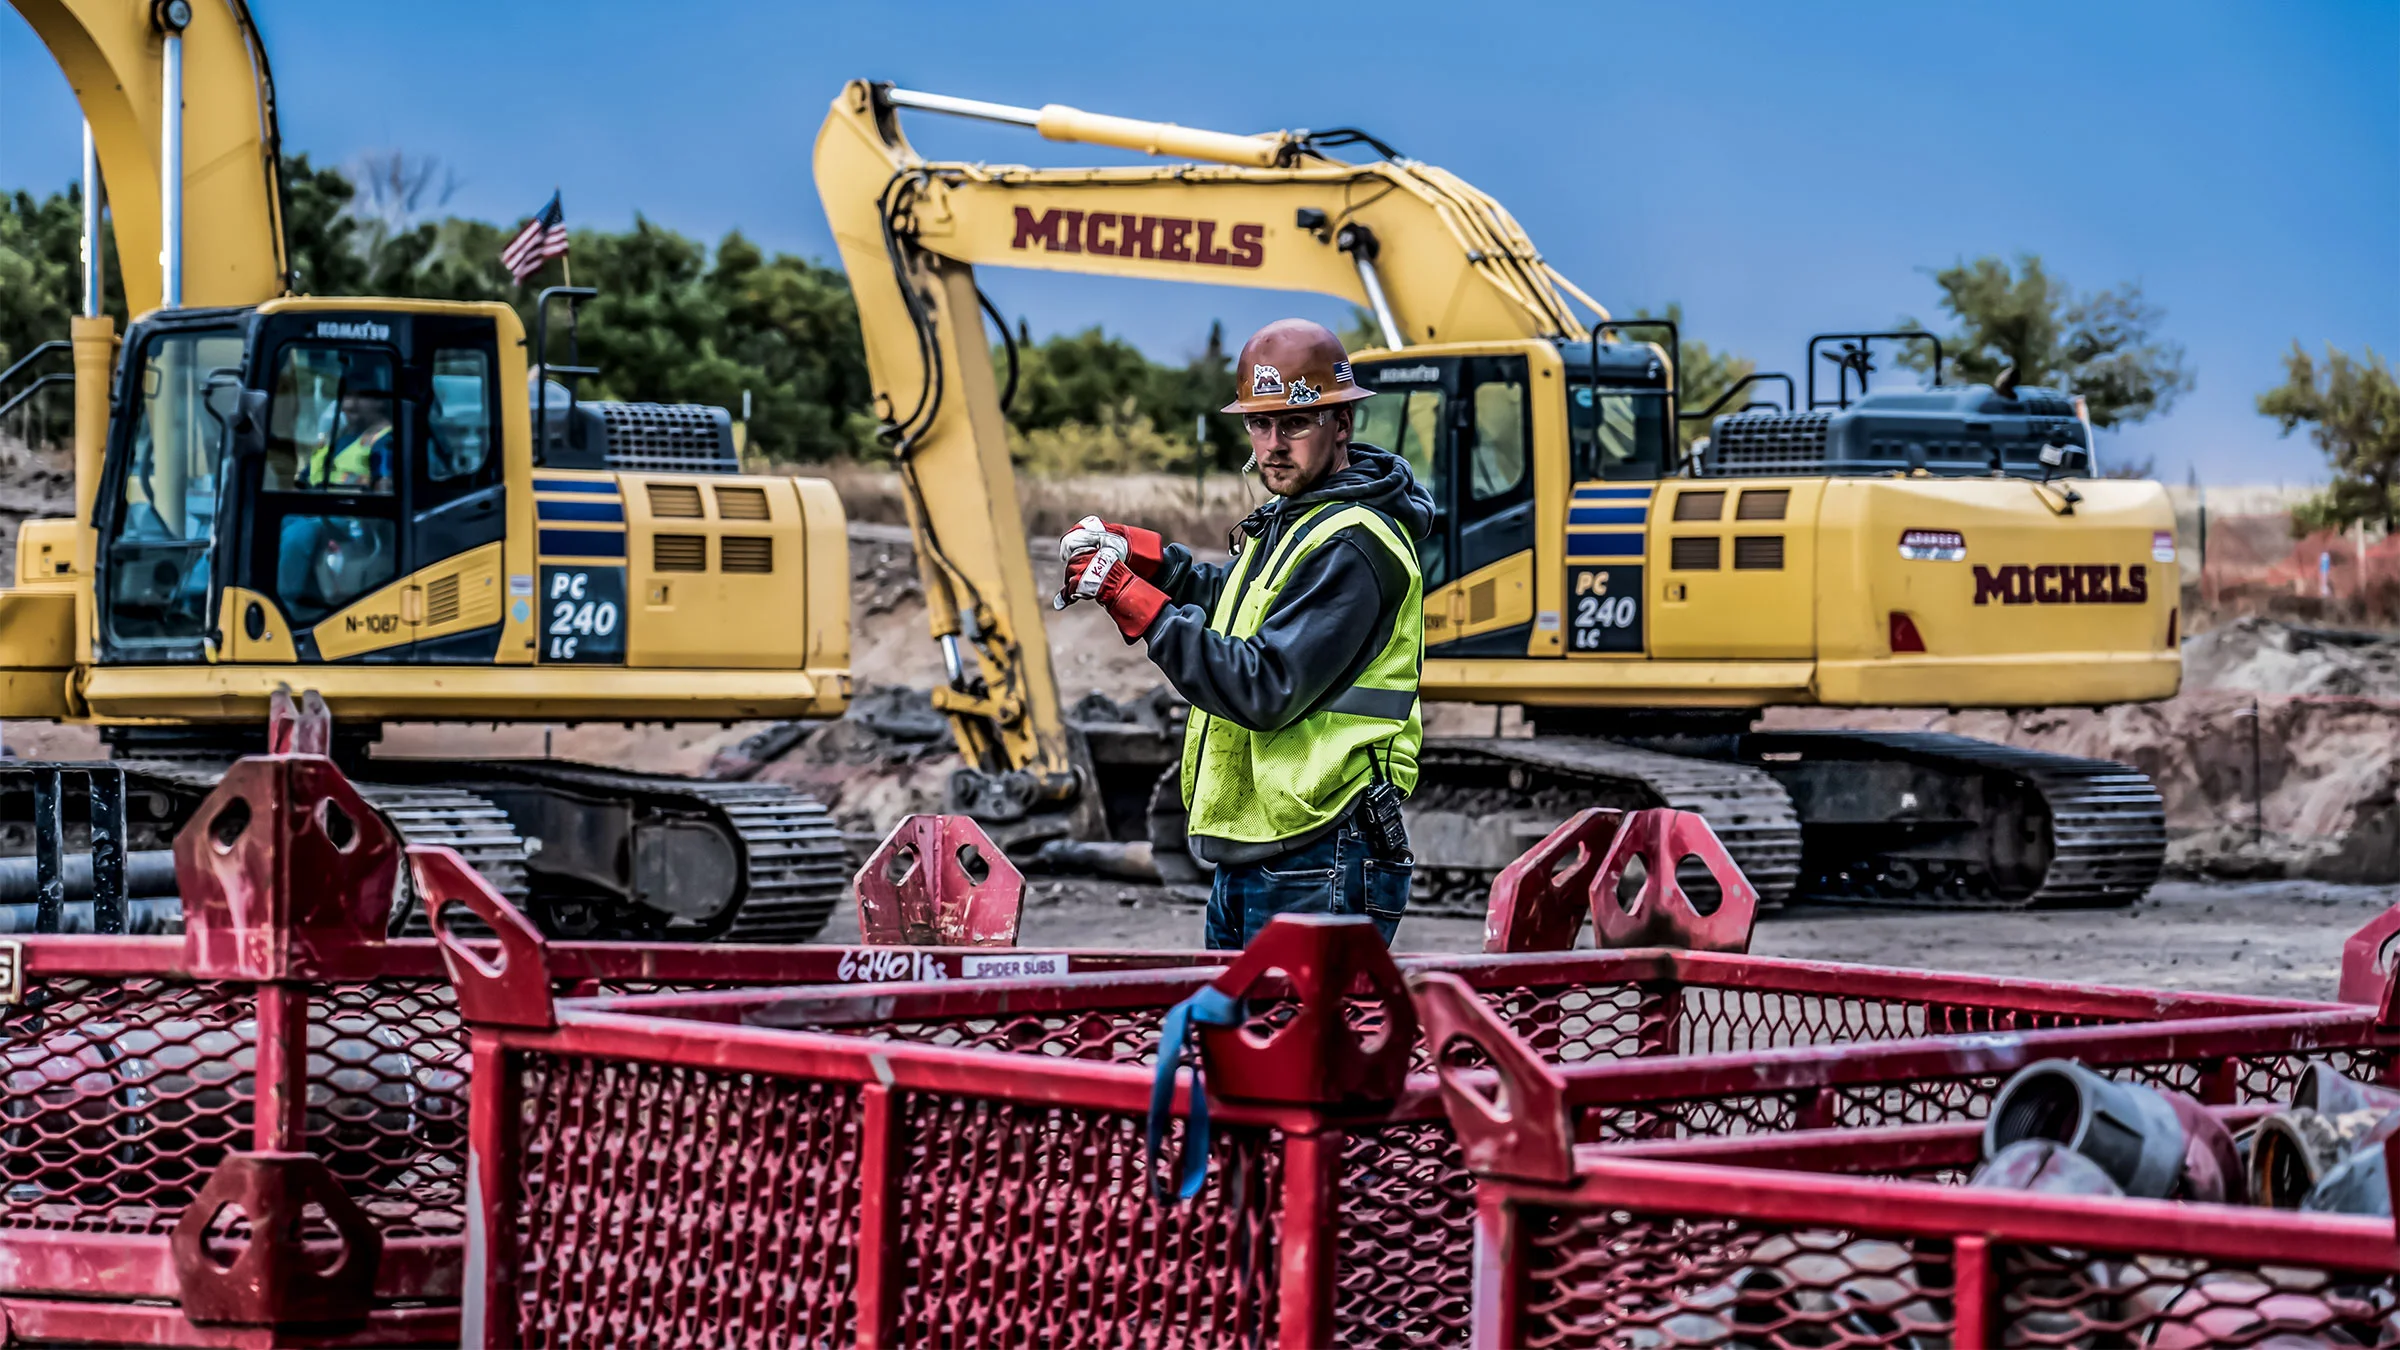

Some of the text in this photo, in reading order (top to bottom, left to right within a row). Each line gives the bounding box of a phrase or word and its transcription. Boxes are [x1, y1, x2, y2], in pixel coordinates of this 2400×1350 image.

[1012, 205, 1266, 269] MICHELS
[317, 319, 390, 341] KOMATSU
[550, 572, 589, 600] PC
[1575, 571, 1609, 596] PC
[1972, 564, 2148, 606] MICHELS
[346, 614, 399, 634] N-1087
[549, 600, 618, 637] 240
[1574, 596, 1636, 628] 240
[549, 636, 578, 659] LC
[1576, 628, 1600, 648] LC
[976, 960, 1055, 977] SPIDER SUBS
